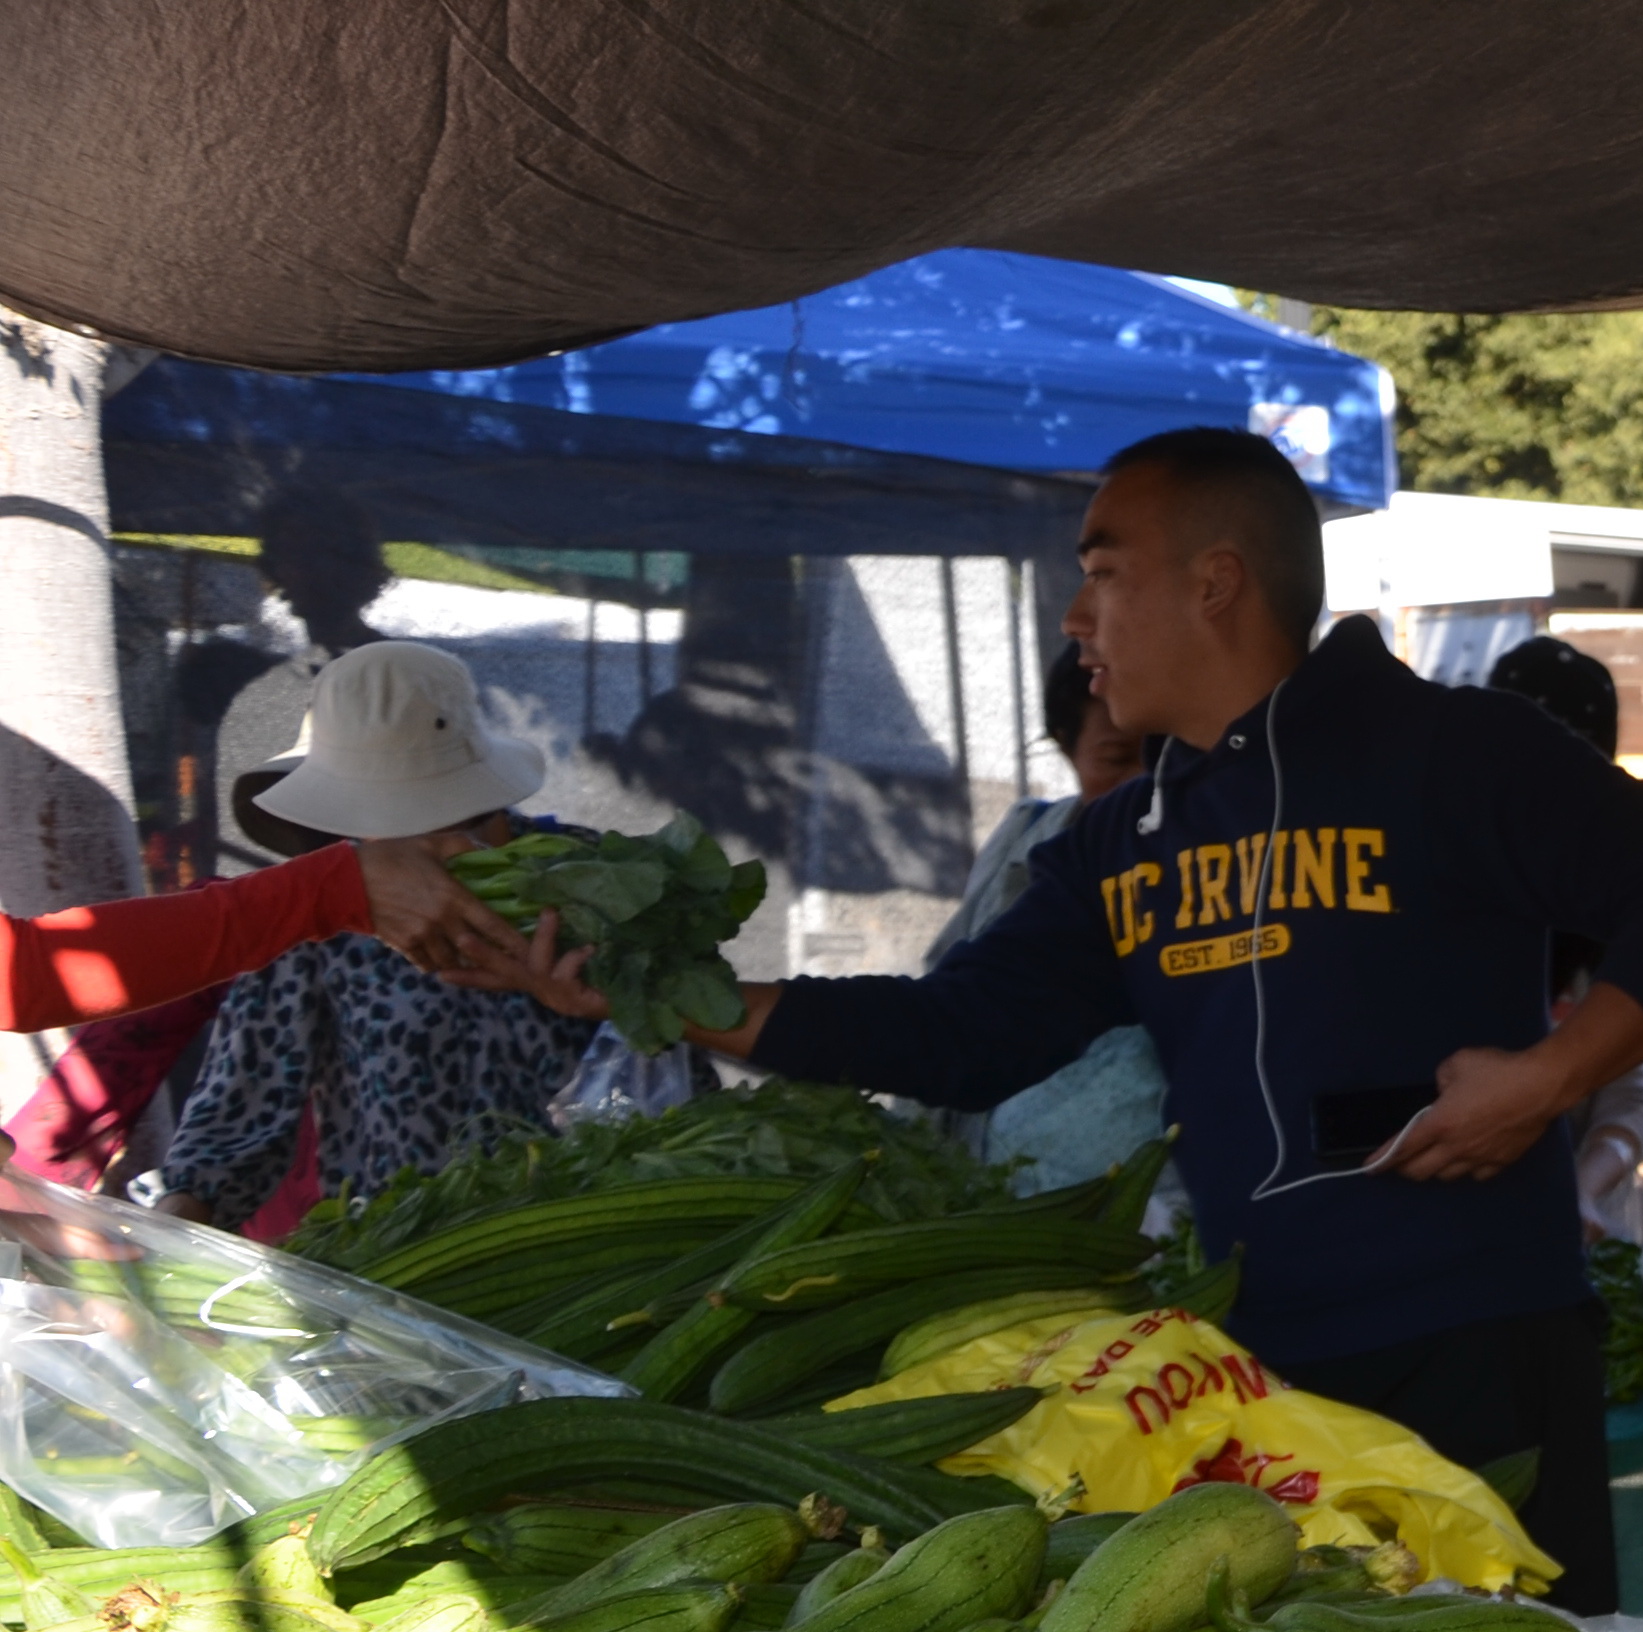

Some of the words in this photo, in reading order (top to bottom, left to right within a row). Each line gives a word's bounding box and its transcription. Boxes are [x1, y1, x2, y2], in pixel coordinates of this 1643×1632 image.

[1100, 862, 1162, 958] UC
[1174, 828, 1394, 929] IRVINE
[1229, 927, 1279, 961] 1965
[1125, 1352, 1224, 1435] YOU
